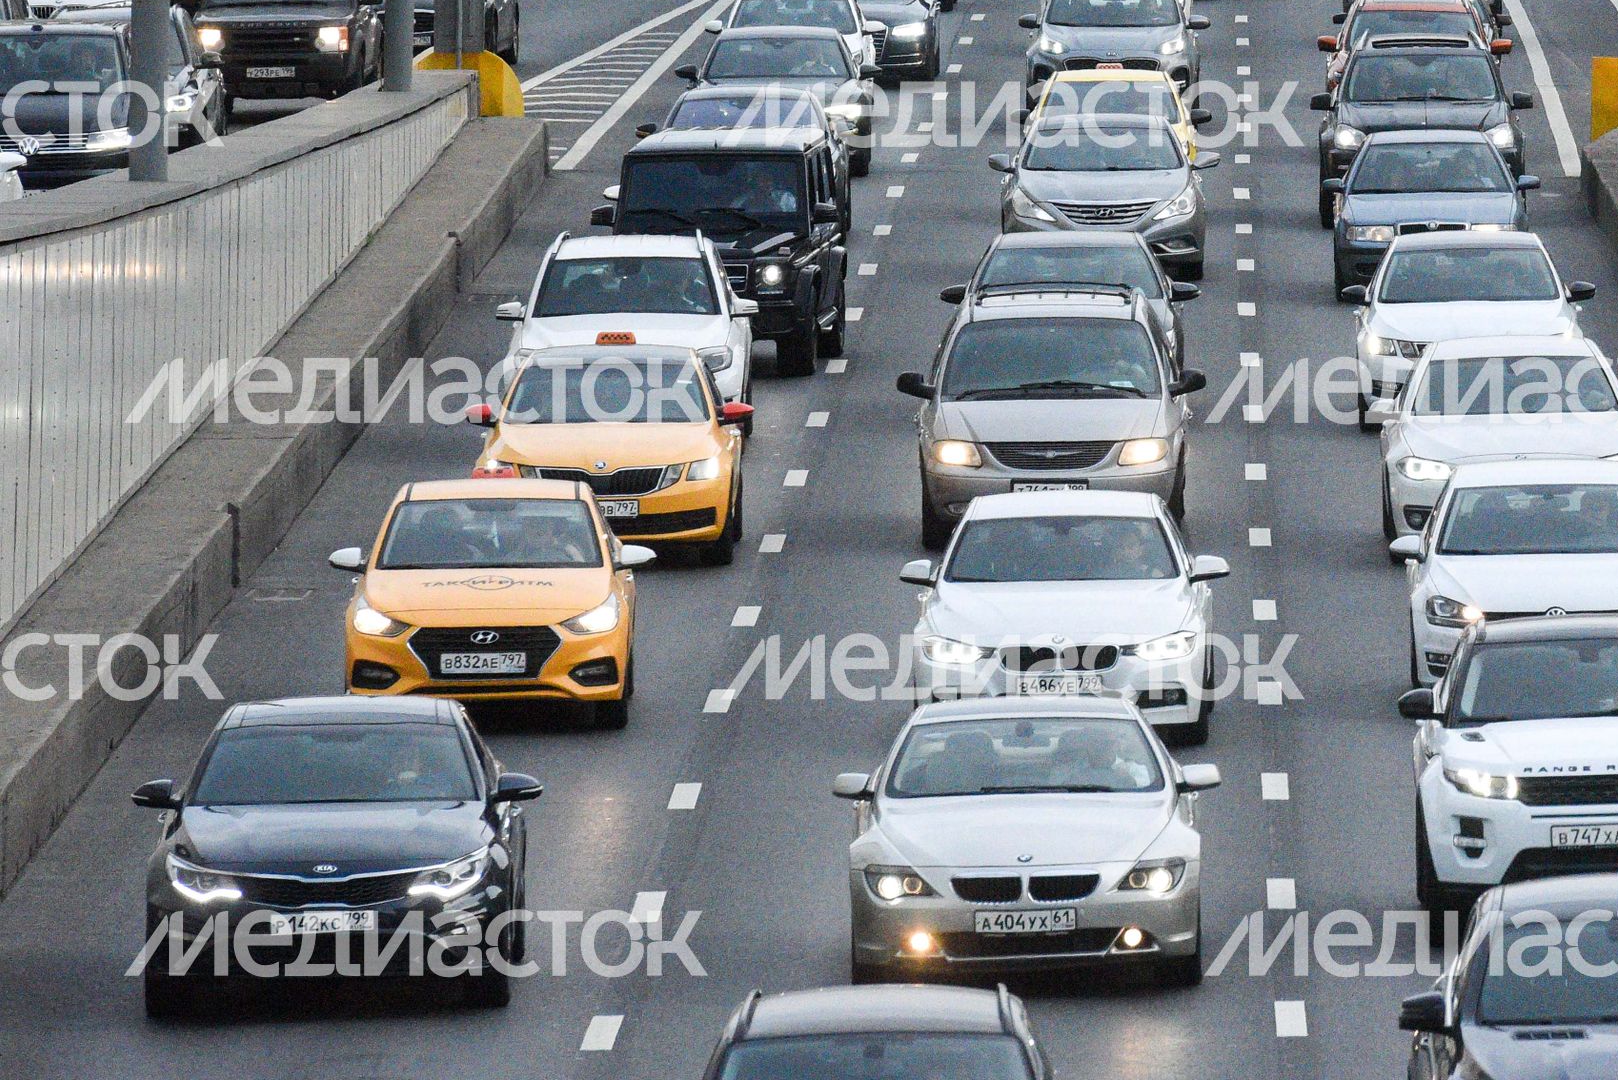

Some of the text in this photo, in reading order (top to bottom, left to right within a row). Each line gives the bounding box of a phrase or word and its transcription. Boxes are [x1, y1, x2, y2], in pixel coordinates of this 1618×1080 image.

[616, 503, 636, 512] 797
[444, 653, 523, 670] В832АЕ 797
[1020, 677, 1075, 692] В486УЕ
[1522, 763, 1591, 773] RANGE
[315, 864, 335, 872] KIA
[276, 911, 370, 931] Р142КС 799
[981, 910, 1070, 930] А404УХ 61
